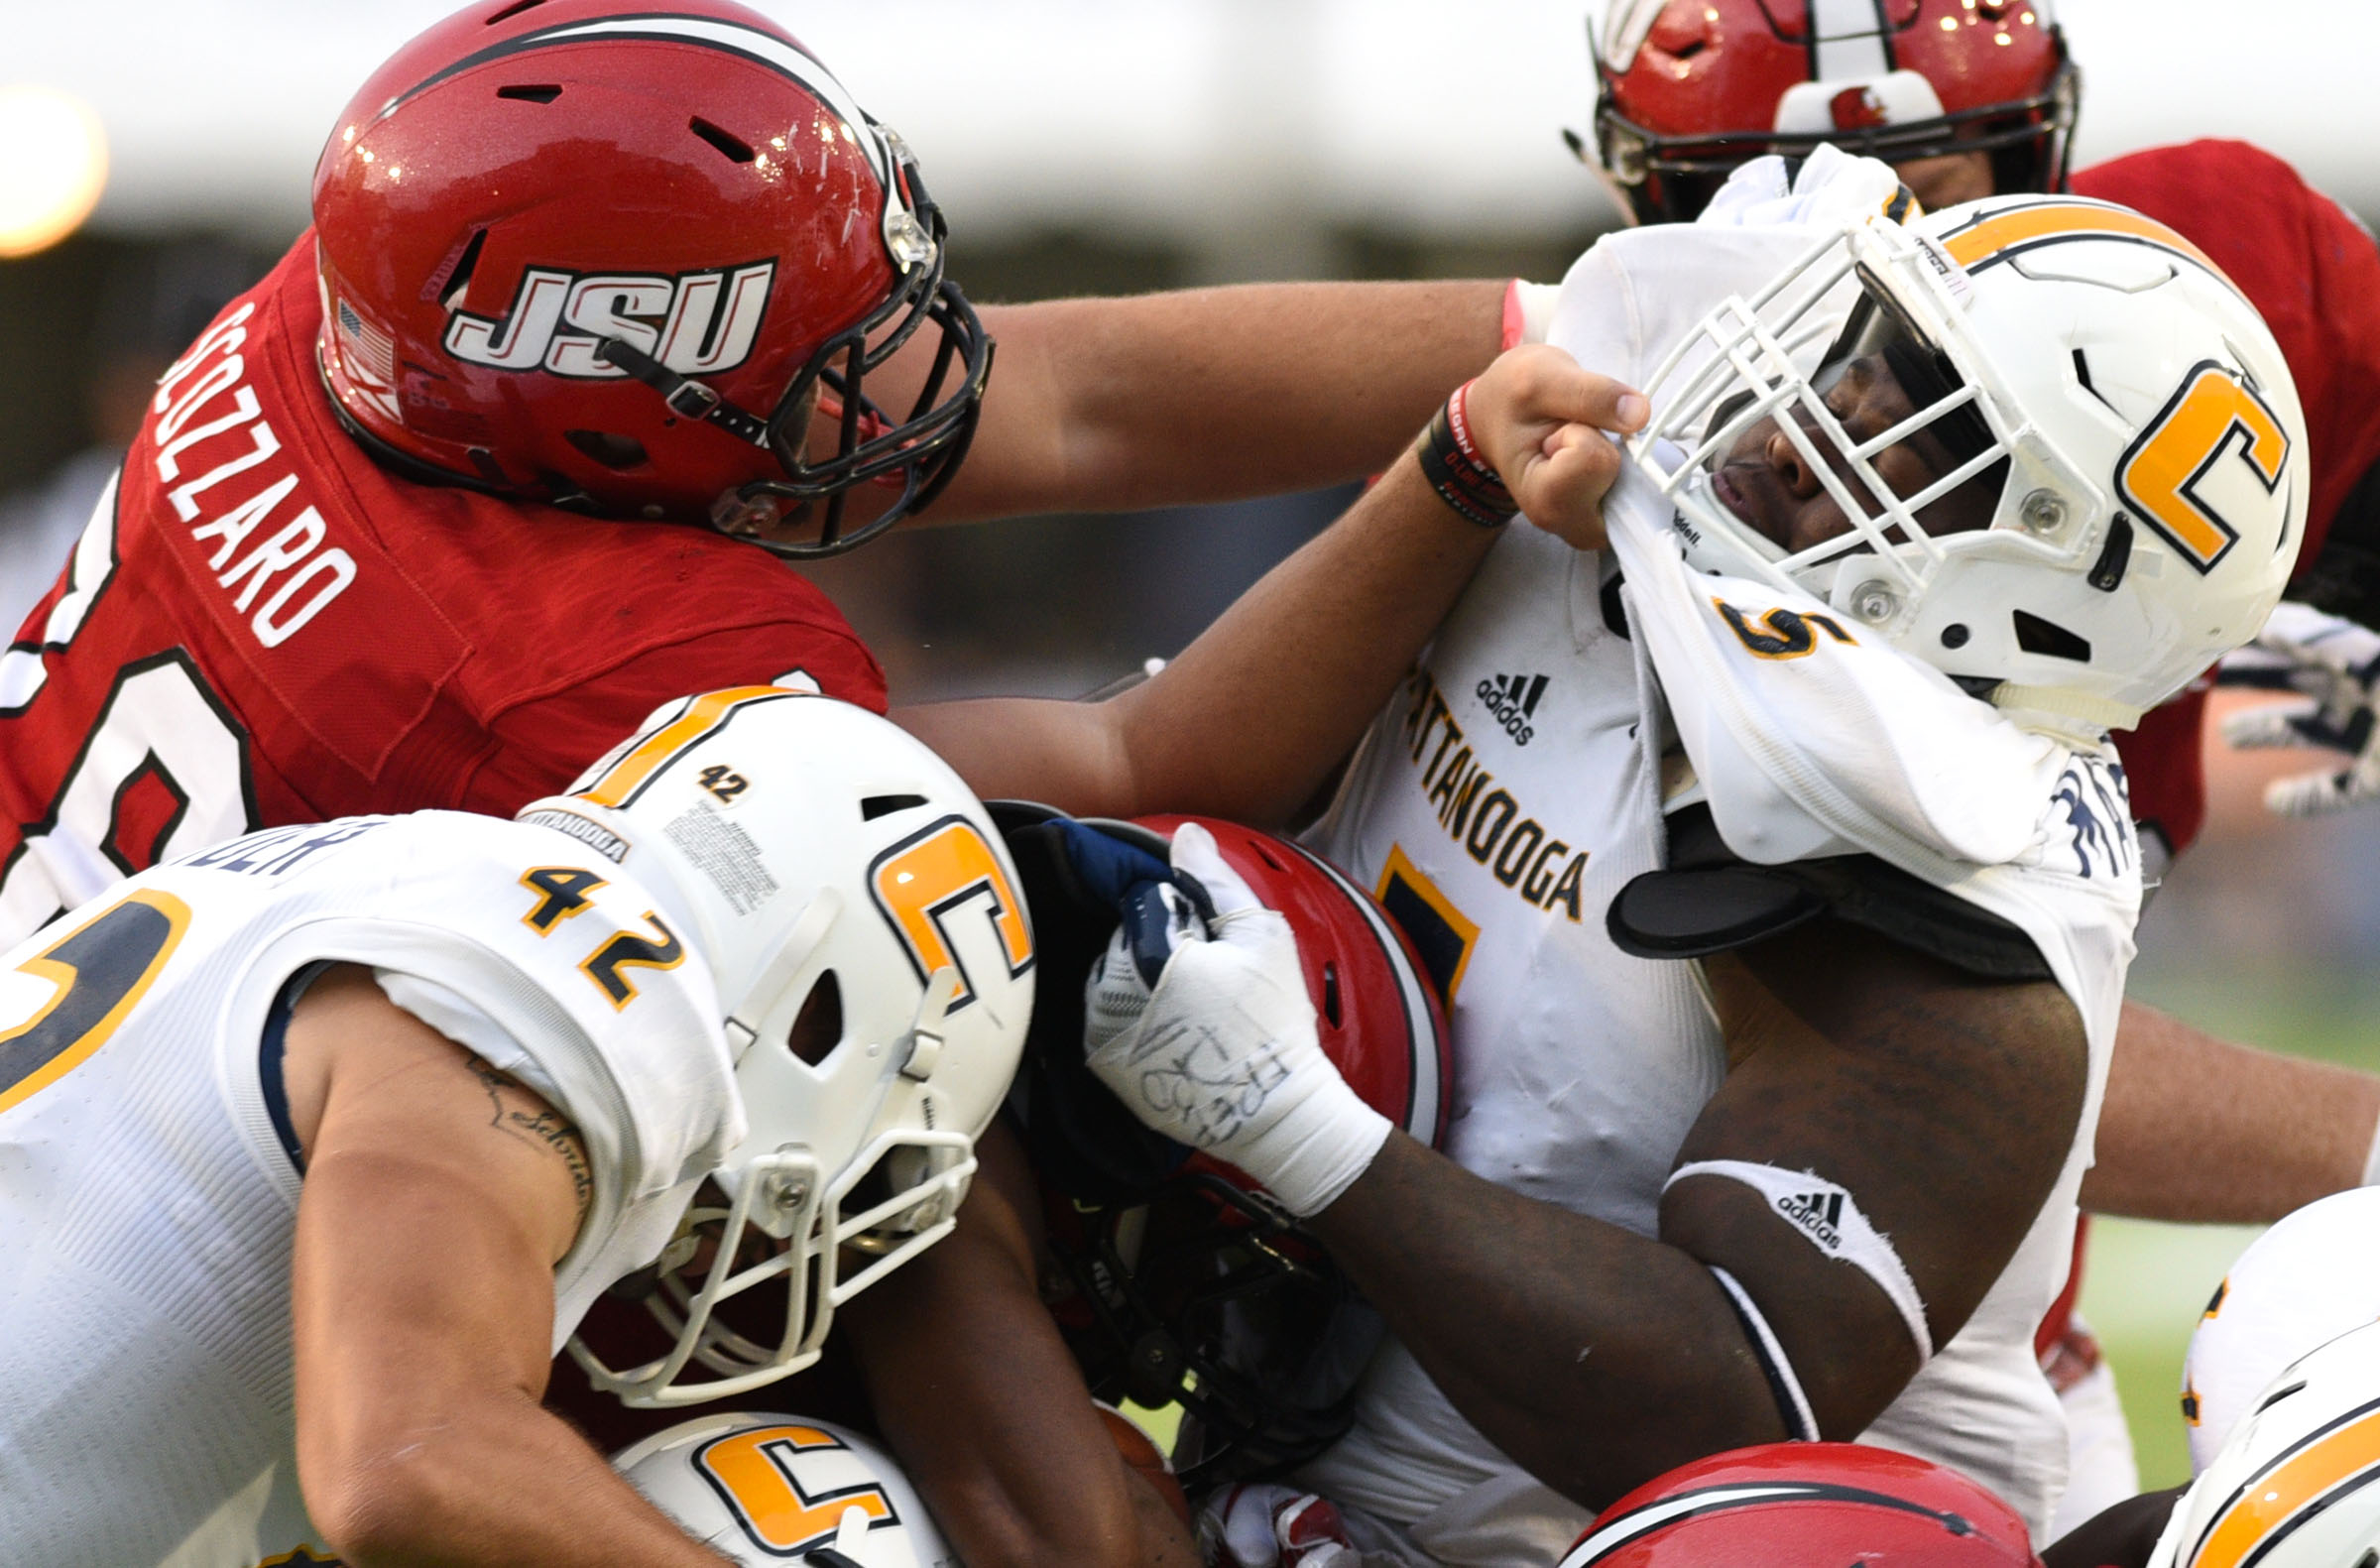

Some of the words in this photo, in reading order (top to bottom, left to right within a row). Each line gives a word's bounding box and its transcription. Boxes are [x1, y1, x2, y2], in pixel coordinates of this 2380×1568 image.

[442, 257, 778, 380] JSU
[155, 302, 357, 649] SCOZZARO
[1714, 596, 1858, 659] 5
[1476, 679, 1534, 746] adidas
[697, 764, 752, 804] 42
[518, 865, 687, 1014] 42
[1776, 1196, 1843, 1251] adidas
